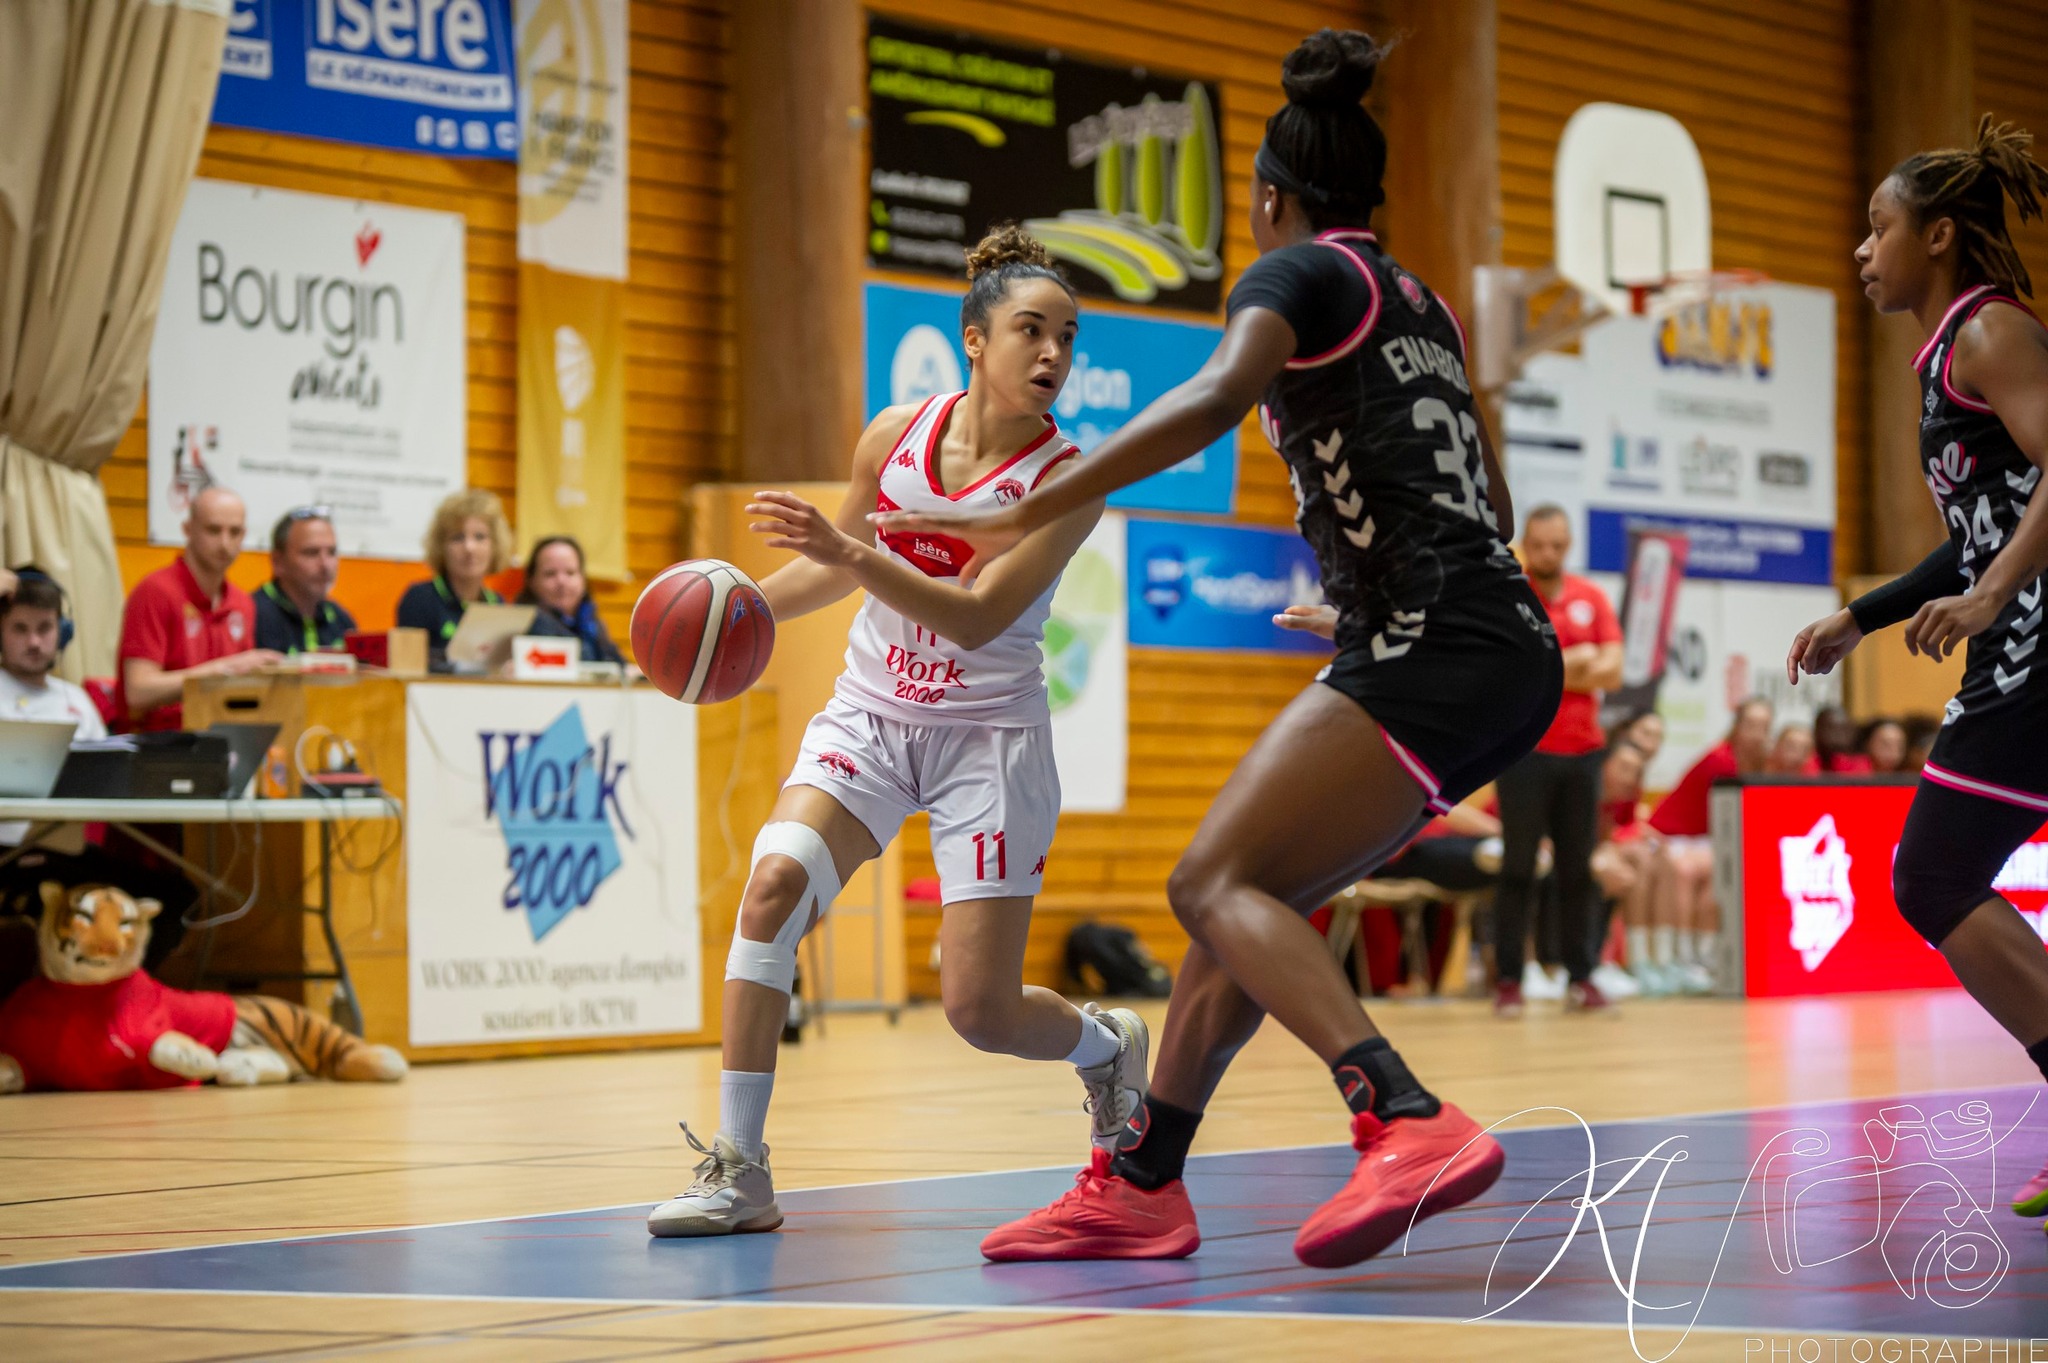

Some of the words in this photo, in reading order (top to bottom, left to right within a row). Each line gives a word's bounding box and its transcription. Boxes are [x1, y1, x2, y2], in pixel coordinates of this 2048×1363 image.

[197, 241, 404, 360] Bourgin
[914, 537, 951, 560] isère
[1948, 494, 2004, 564] 24
[885, 644, 970, 690] Work
[894, 681, 946, 704] 2000
[476, 730, 637, 843] Work
[501, 842, 602, 911] 2000
[972, 830, 1006, 881] 11
